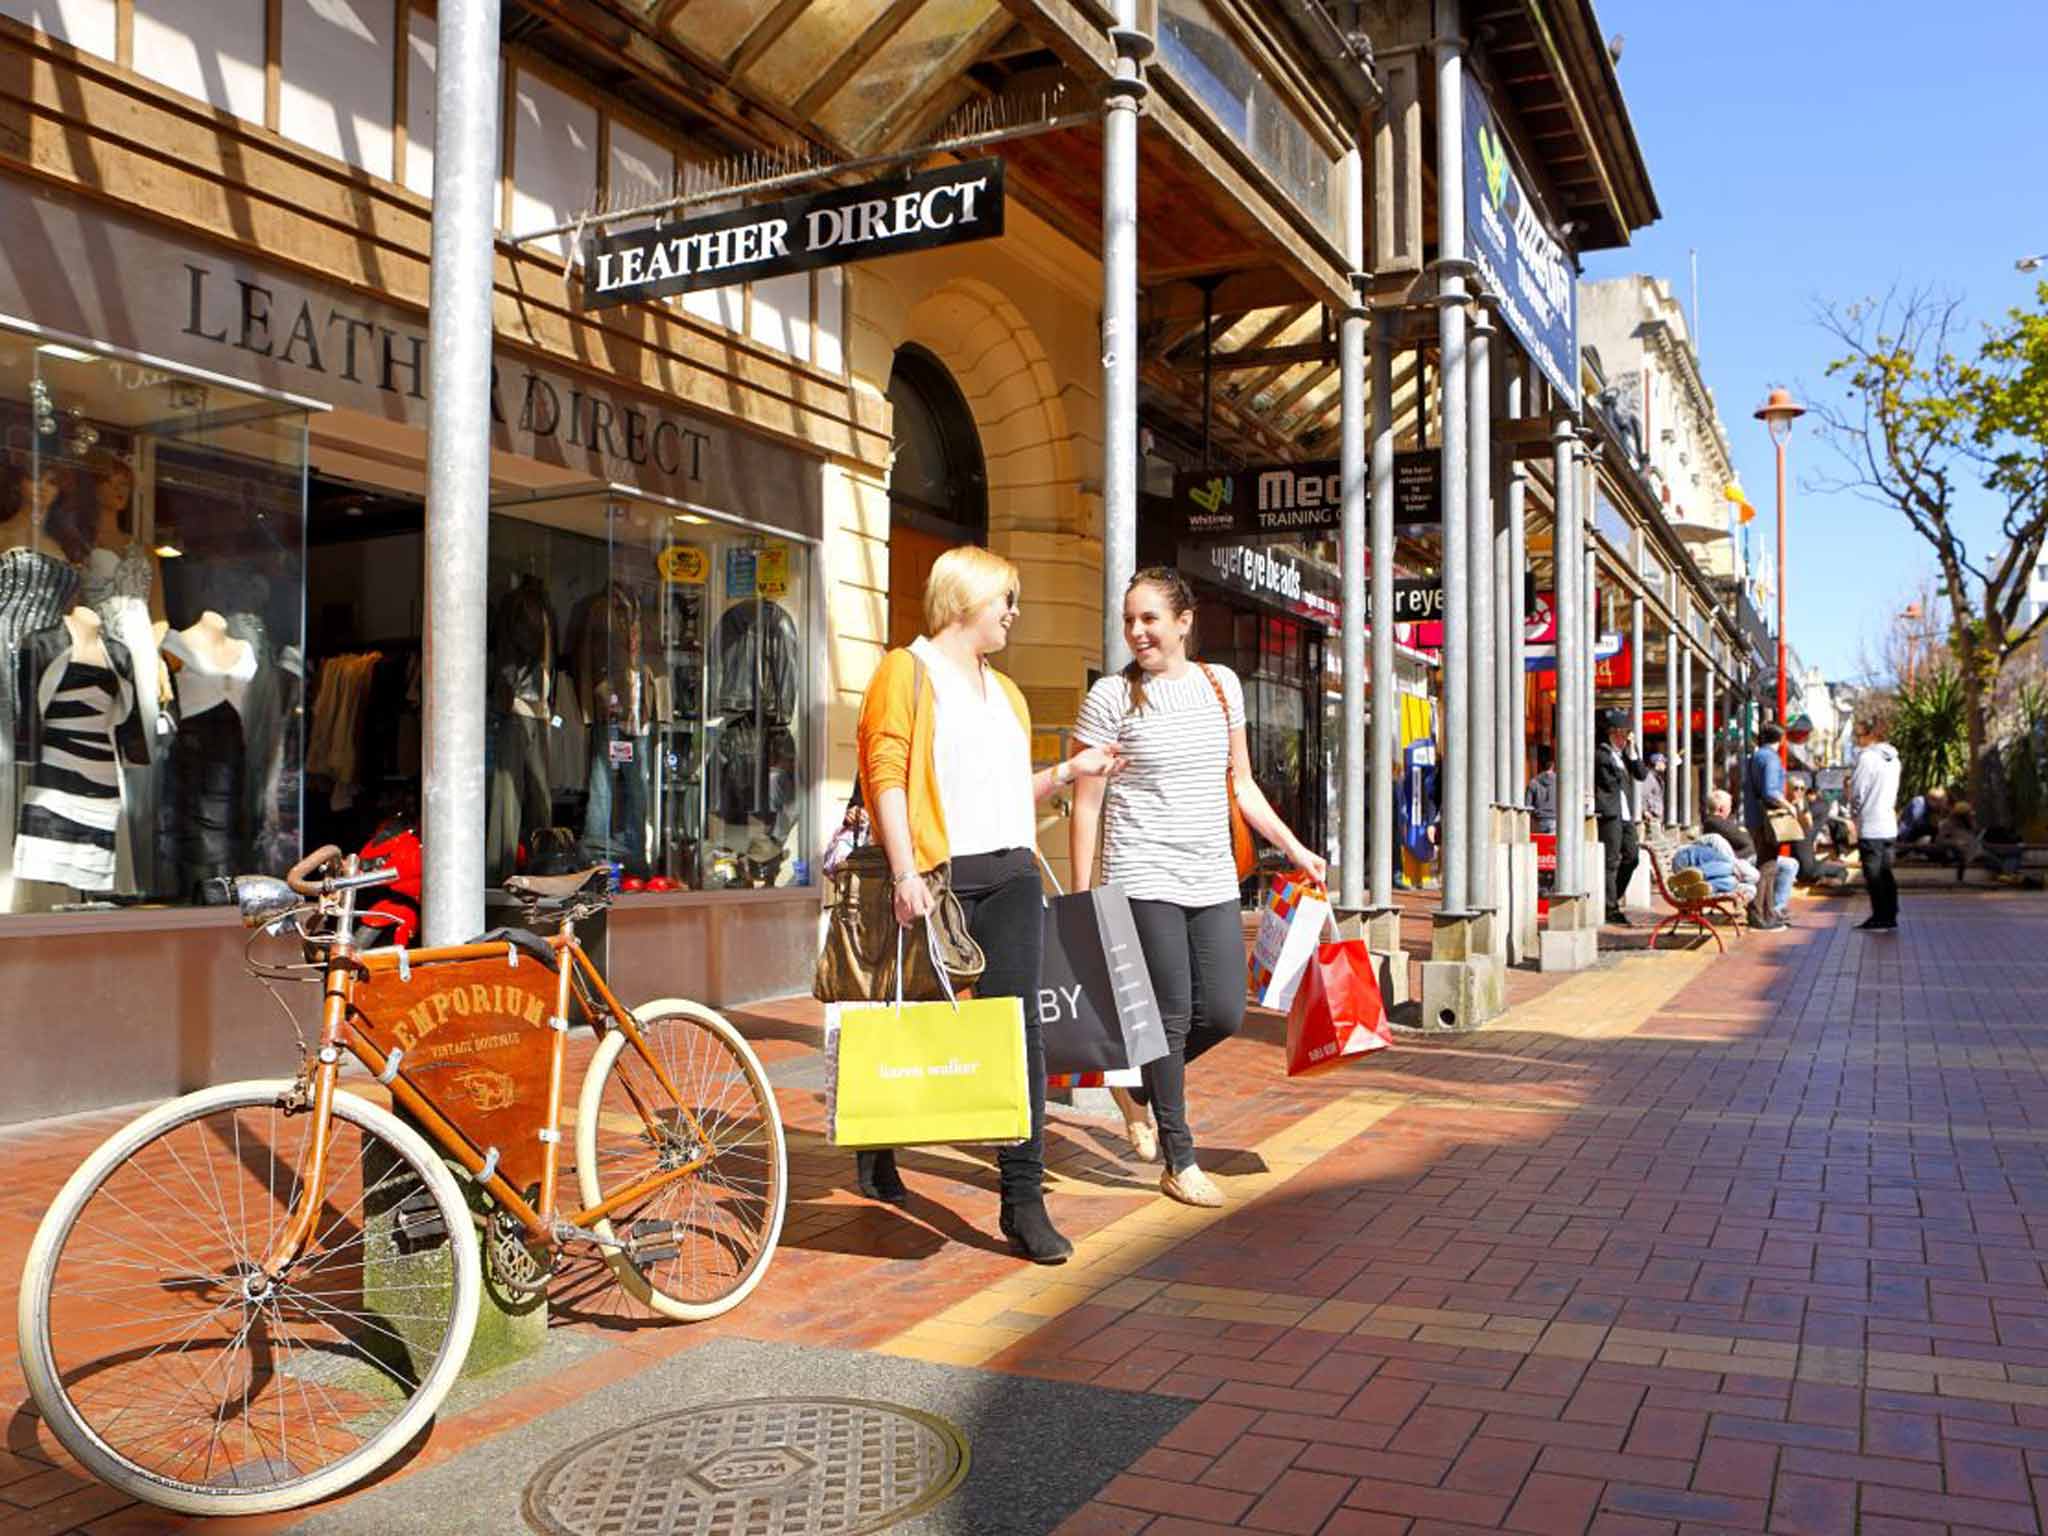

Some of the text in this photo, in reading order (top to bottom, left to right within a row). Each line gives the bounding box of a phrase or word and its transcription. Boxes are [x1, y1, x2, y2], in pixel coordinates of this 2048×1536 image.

[595, 178, 988, 293] LEATHER DIRECT
[182, 263, 712, 484] LEATH DIRECT
[1258, 508, 1332, 528] TRAINING
[1243, 547, 1266, 591] eye
[1265, 546, 1301, 601] beads
[1409, 588, 1444, 617] eye
[391, 983, 546, 1053] EMPORIUM
[431, 1039, 473, 1059] VINTAGE
[927, 1056, 982, 1078] walker
